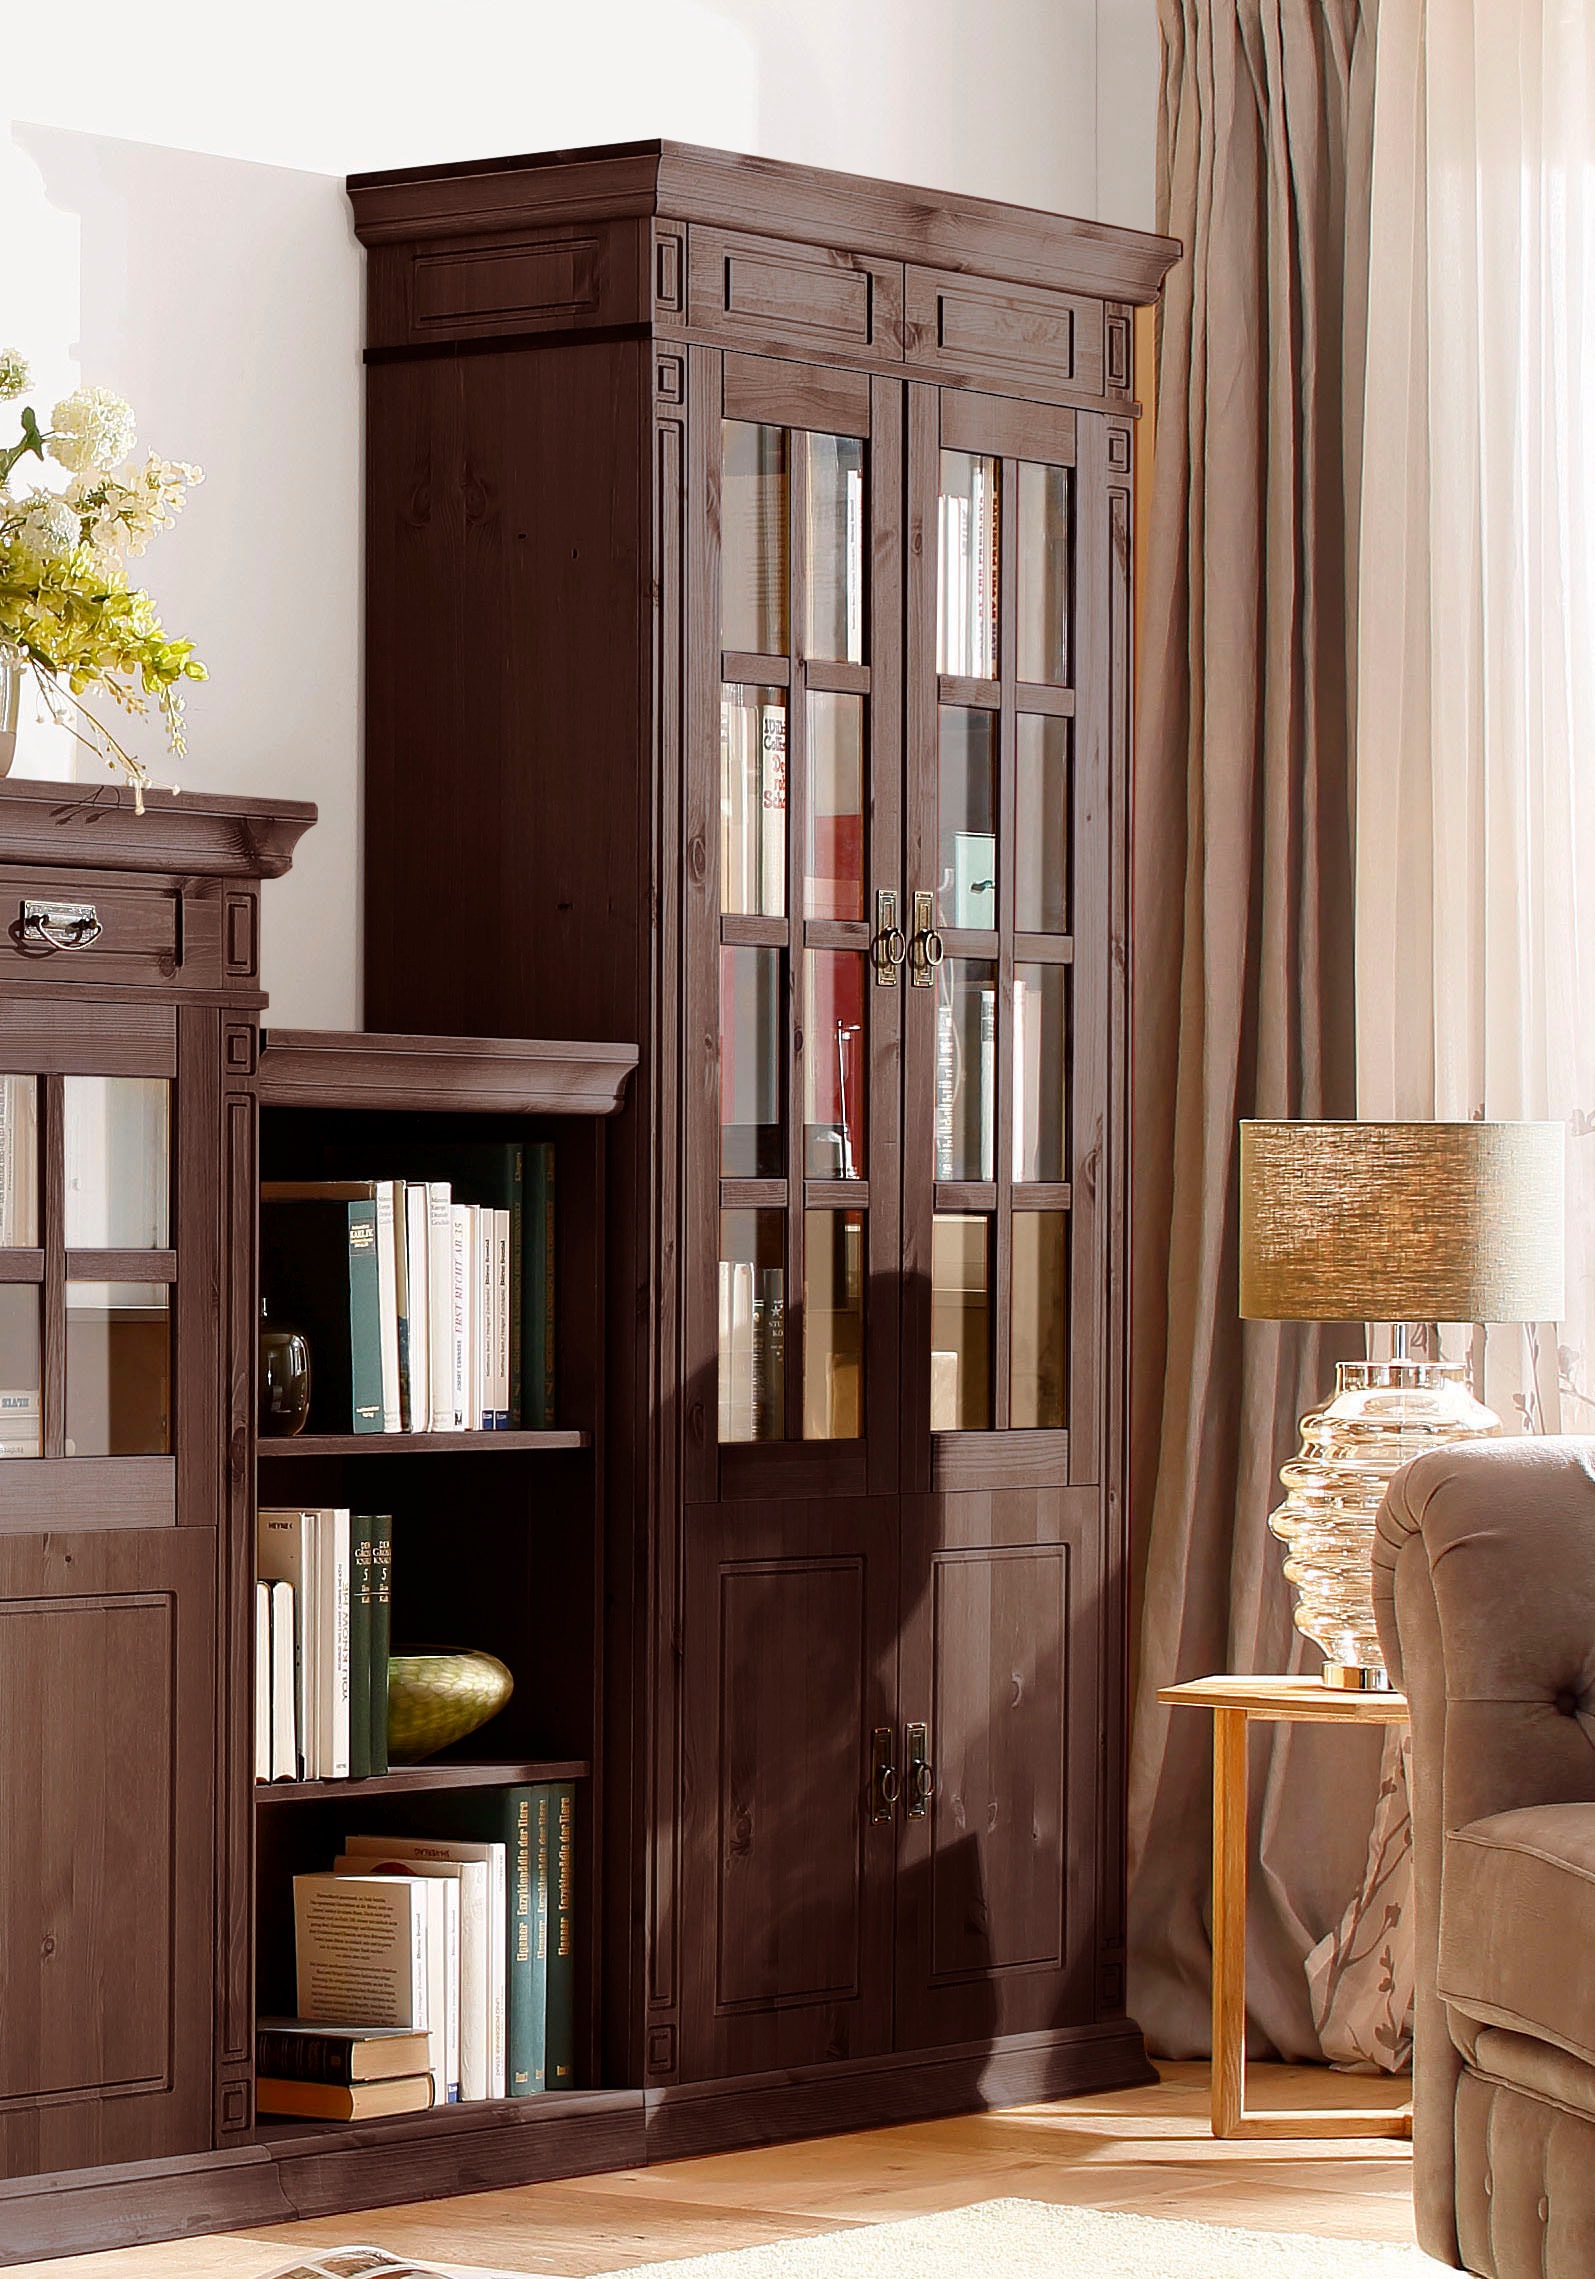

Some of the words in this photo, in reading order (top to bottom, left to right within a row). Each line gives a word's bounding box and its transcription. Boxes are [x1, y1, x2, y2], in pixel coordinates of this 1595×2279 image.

[455, 1222, 463, 1237] 35
[455, 1258, 463, 1299] RECHT
[455, 1303, 463, 1334] ERST
[363, 1568, 368, 1581] 5
[381, 1567, 387, 1580] 5
[517, 1801, 528, 1827] Tiere
[558, 1797, 570, 1823] Tiere
[517, 1828, 528, 1847] der
[558, 1824, 570, 1842] der
[517, 1849, 528, 1915] Enzyklopädie
[558, 1845, 570, 1910] Enzyklopädie
